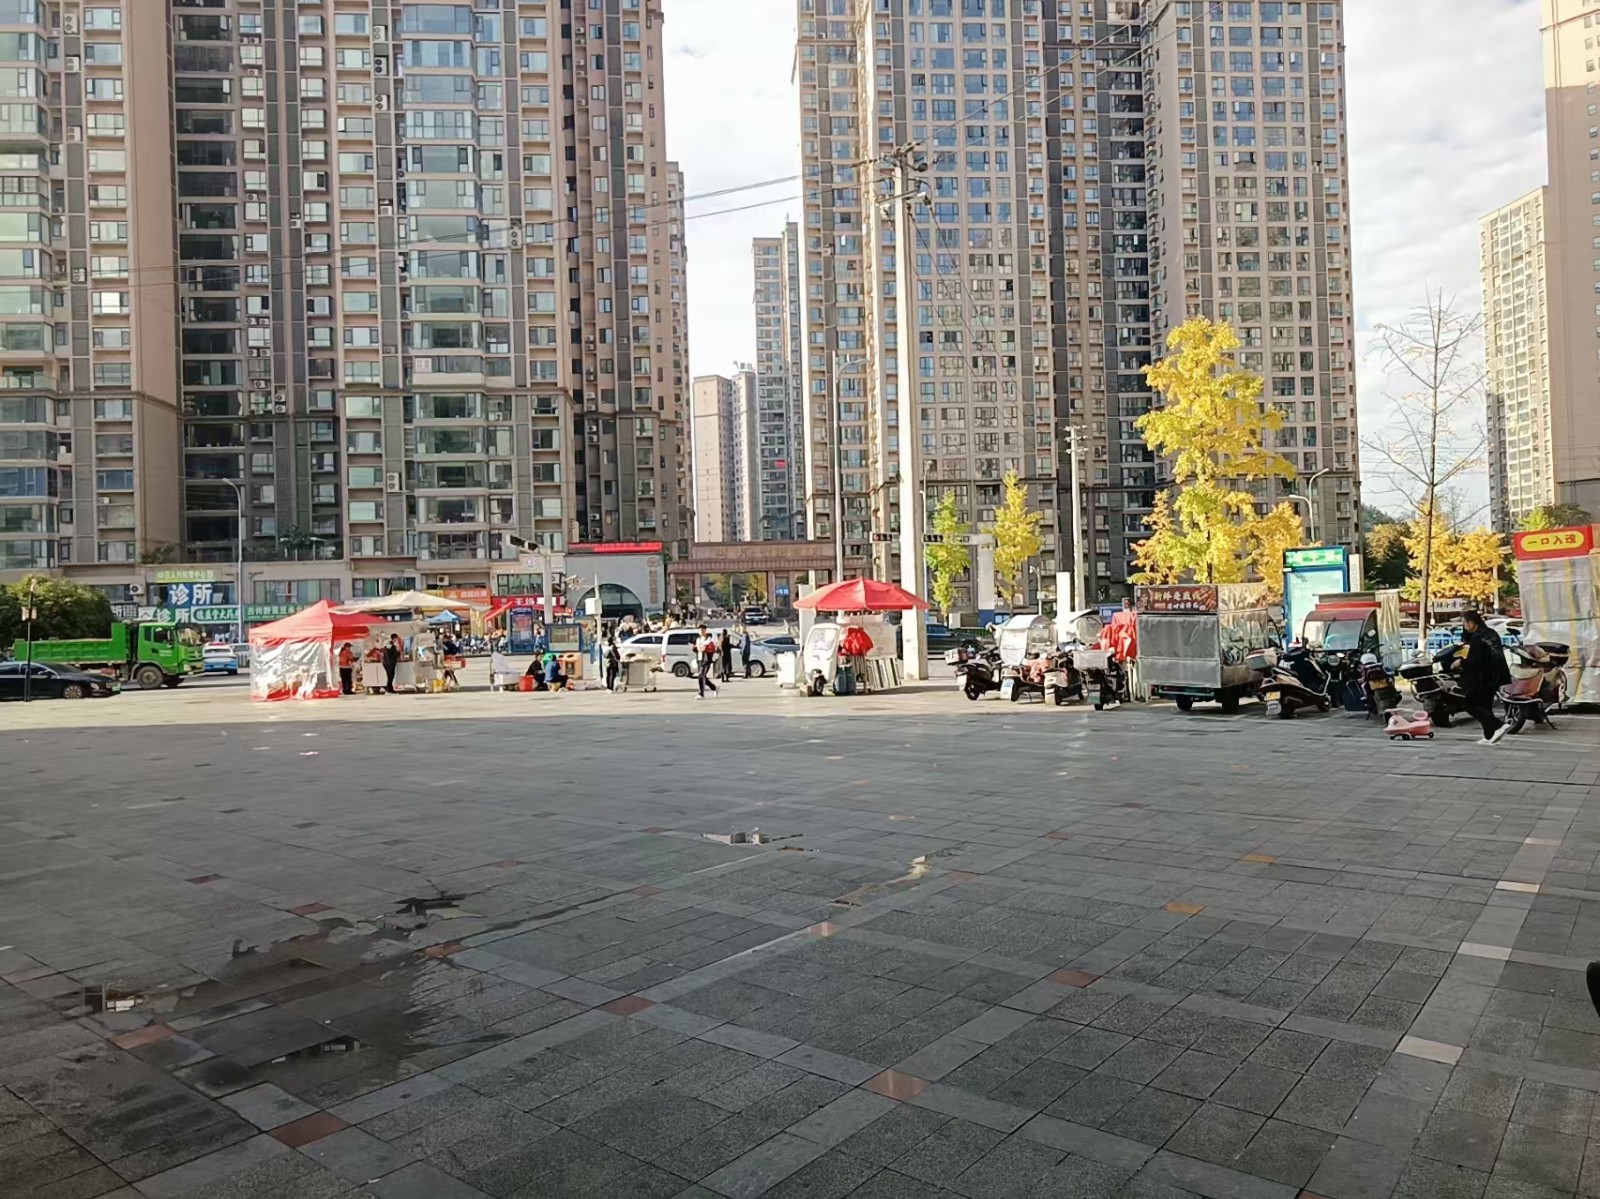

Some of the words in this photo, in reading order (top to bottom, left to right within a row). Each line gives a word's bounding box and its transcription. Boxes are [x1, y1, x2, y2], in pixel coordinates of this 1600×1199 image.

[1528, 534, 1576, 545] 一口入魂
[169, 583, 213, 606] 诊所
[156, 608, 190, 623] 诊所
